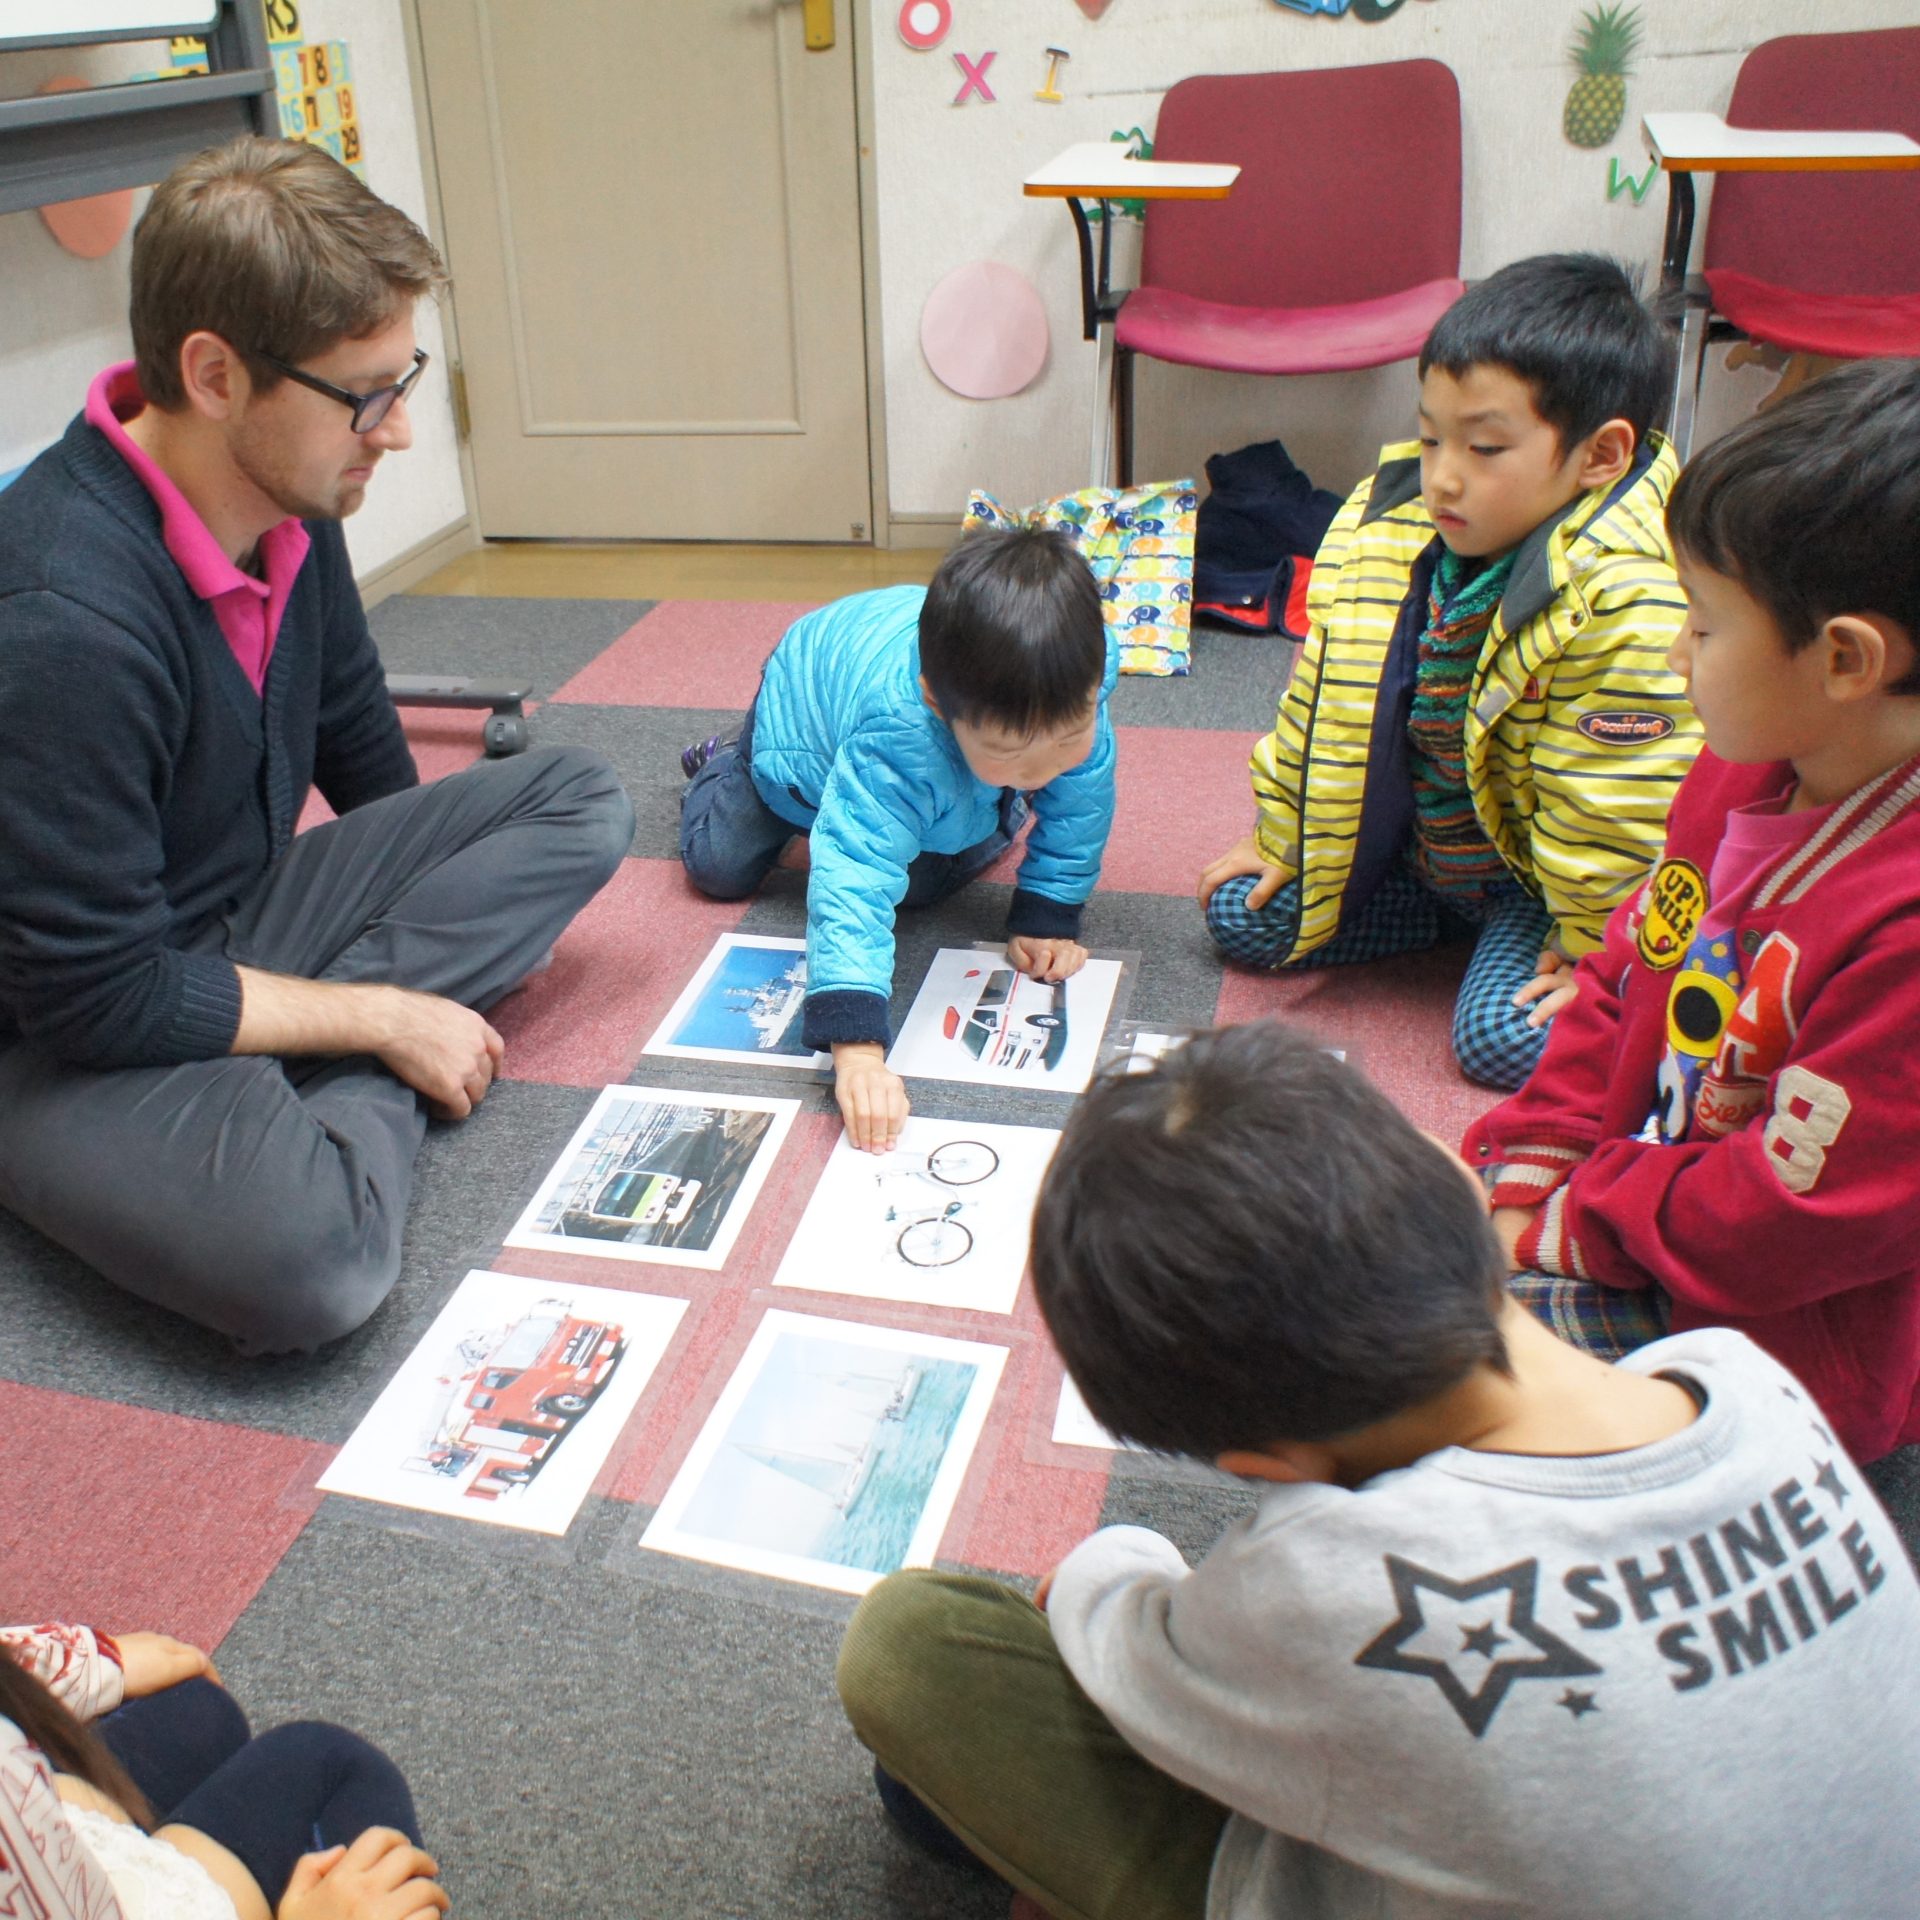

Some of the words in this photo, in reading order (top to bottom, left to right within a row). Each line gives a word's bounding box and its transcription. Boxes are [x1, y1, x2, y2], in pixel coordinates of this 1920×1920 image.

[314, 46, 328, 85] 8
[952, 52, 998, 103] X
[1034, 47, 1070, 102] I
[1607, 157, 1659, 203] W
[1653, 882, 1694, 942] MILE
[1664, 868, 1701, 915] UP!
[1763, 1065, 1852, 1194] 8
[1563, 1477, 1830, 1630] SHINE
[1656, 1519, 1886, 1693] SMILE
